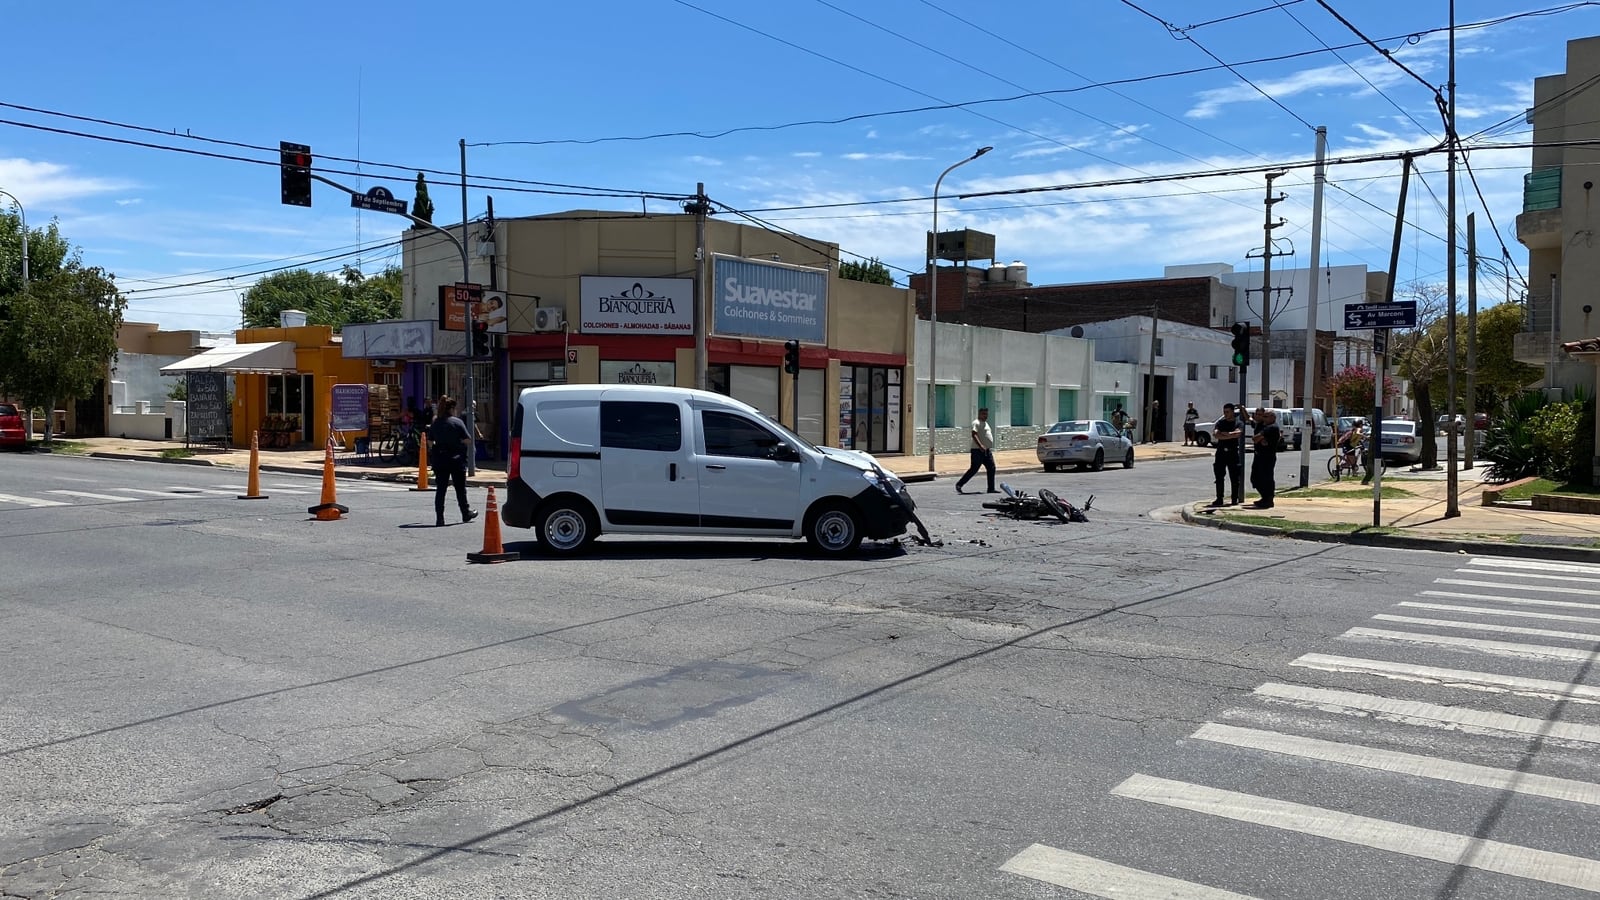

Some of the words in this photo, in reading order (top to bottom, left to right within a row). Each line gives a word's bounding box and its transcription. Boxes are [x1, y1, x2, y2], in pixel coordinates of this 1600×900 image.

[373, 197, 403, 207] Septiembre
[456, 290, 469, 301] 50
[724, 277, 817, 311] Suavestar
[724, 305, 768, 320] Colchones
[769, 311, 776, 321] &
[777, 312, 817, 325] Sommiers
[664, 321, 691, 330] SÁBANAS
[189, 375, 215, 383] PALTA
[190, 393, 217, 402] BANANA
